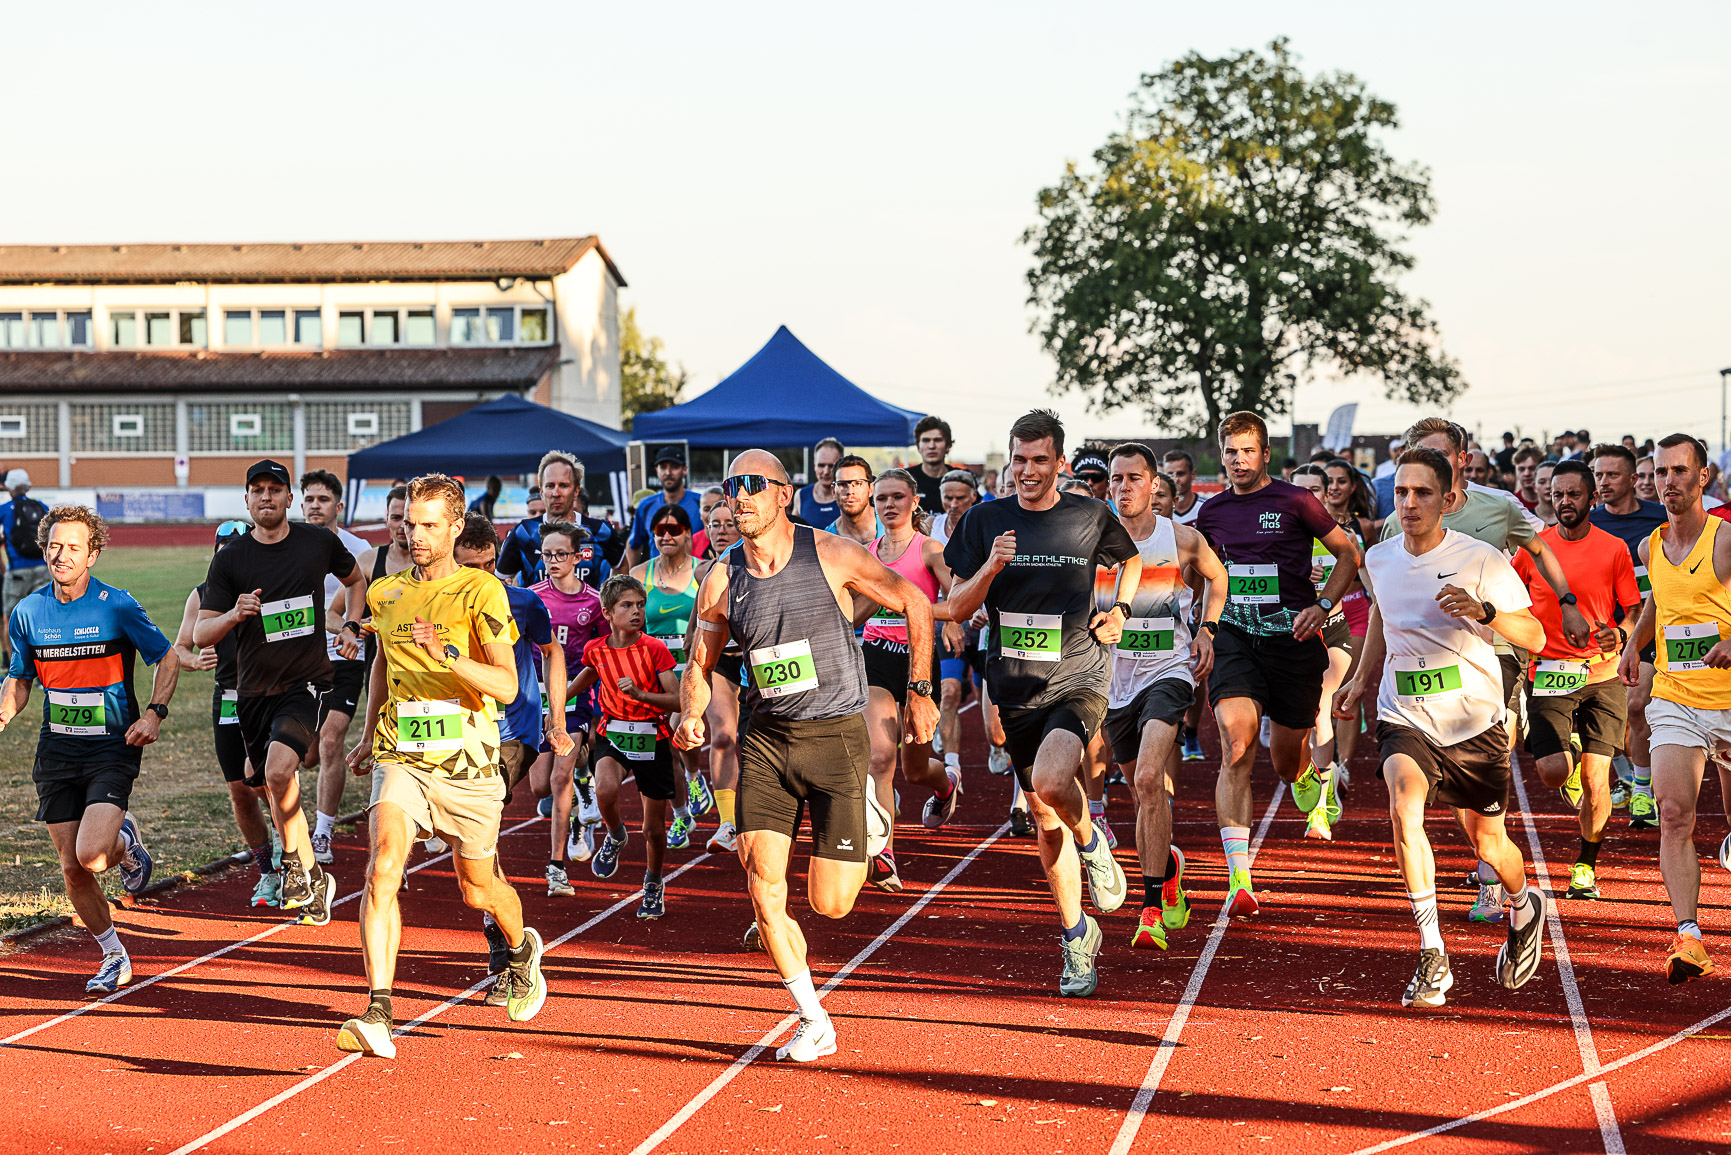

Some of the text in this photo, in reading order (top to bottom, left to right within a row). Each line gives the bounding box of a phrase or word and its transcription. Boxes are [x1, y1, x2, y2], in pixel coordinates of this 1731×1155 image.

[1259, 511, 1281, 523] play
[1262, 520, 1280, 529] itas
[1032, 555, 1088, 567] ATHLETIKER
[1238, 578, 1268, 593] 249
[274, 611, 306, 629] 192
[1011, 630, 1048, 649] 252
[1128, 633, 1160, 648] 231
[43, 644, 106, 658] MERGELSTETTEN
[1675, 640, 1710, 659] 276
[763, 661, 801, 685] 230
[1545, 673, 1577, 688] 209
[1407, 671, 1444, 692] 191
[59, 707, 93, 724] 279
[409, 718, 445, 738] 211
[615, 734, 646, 750] 213
